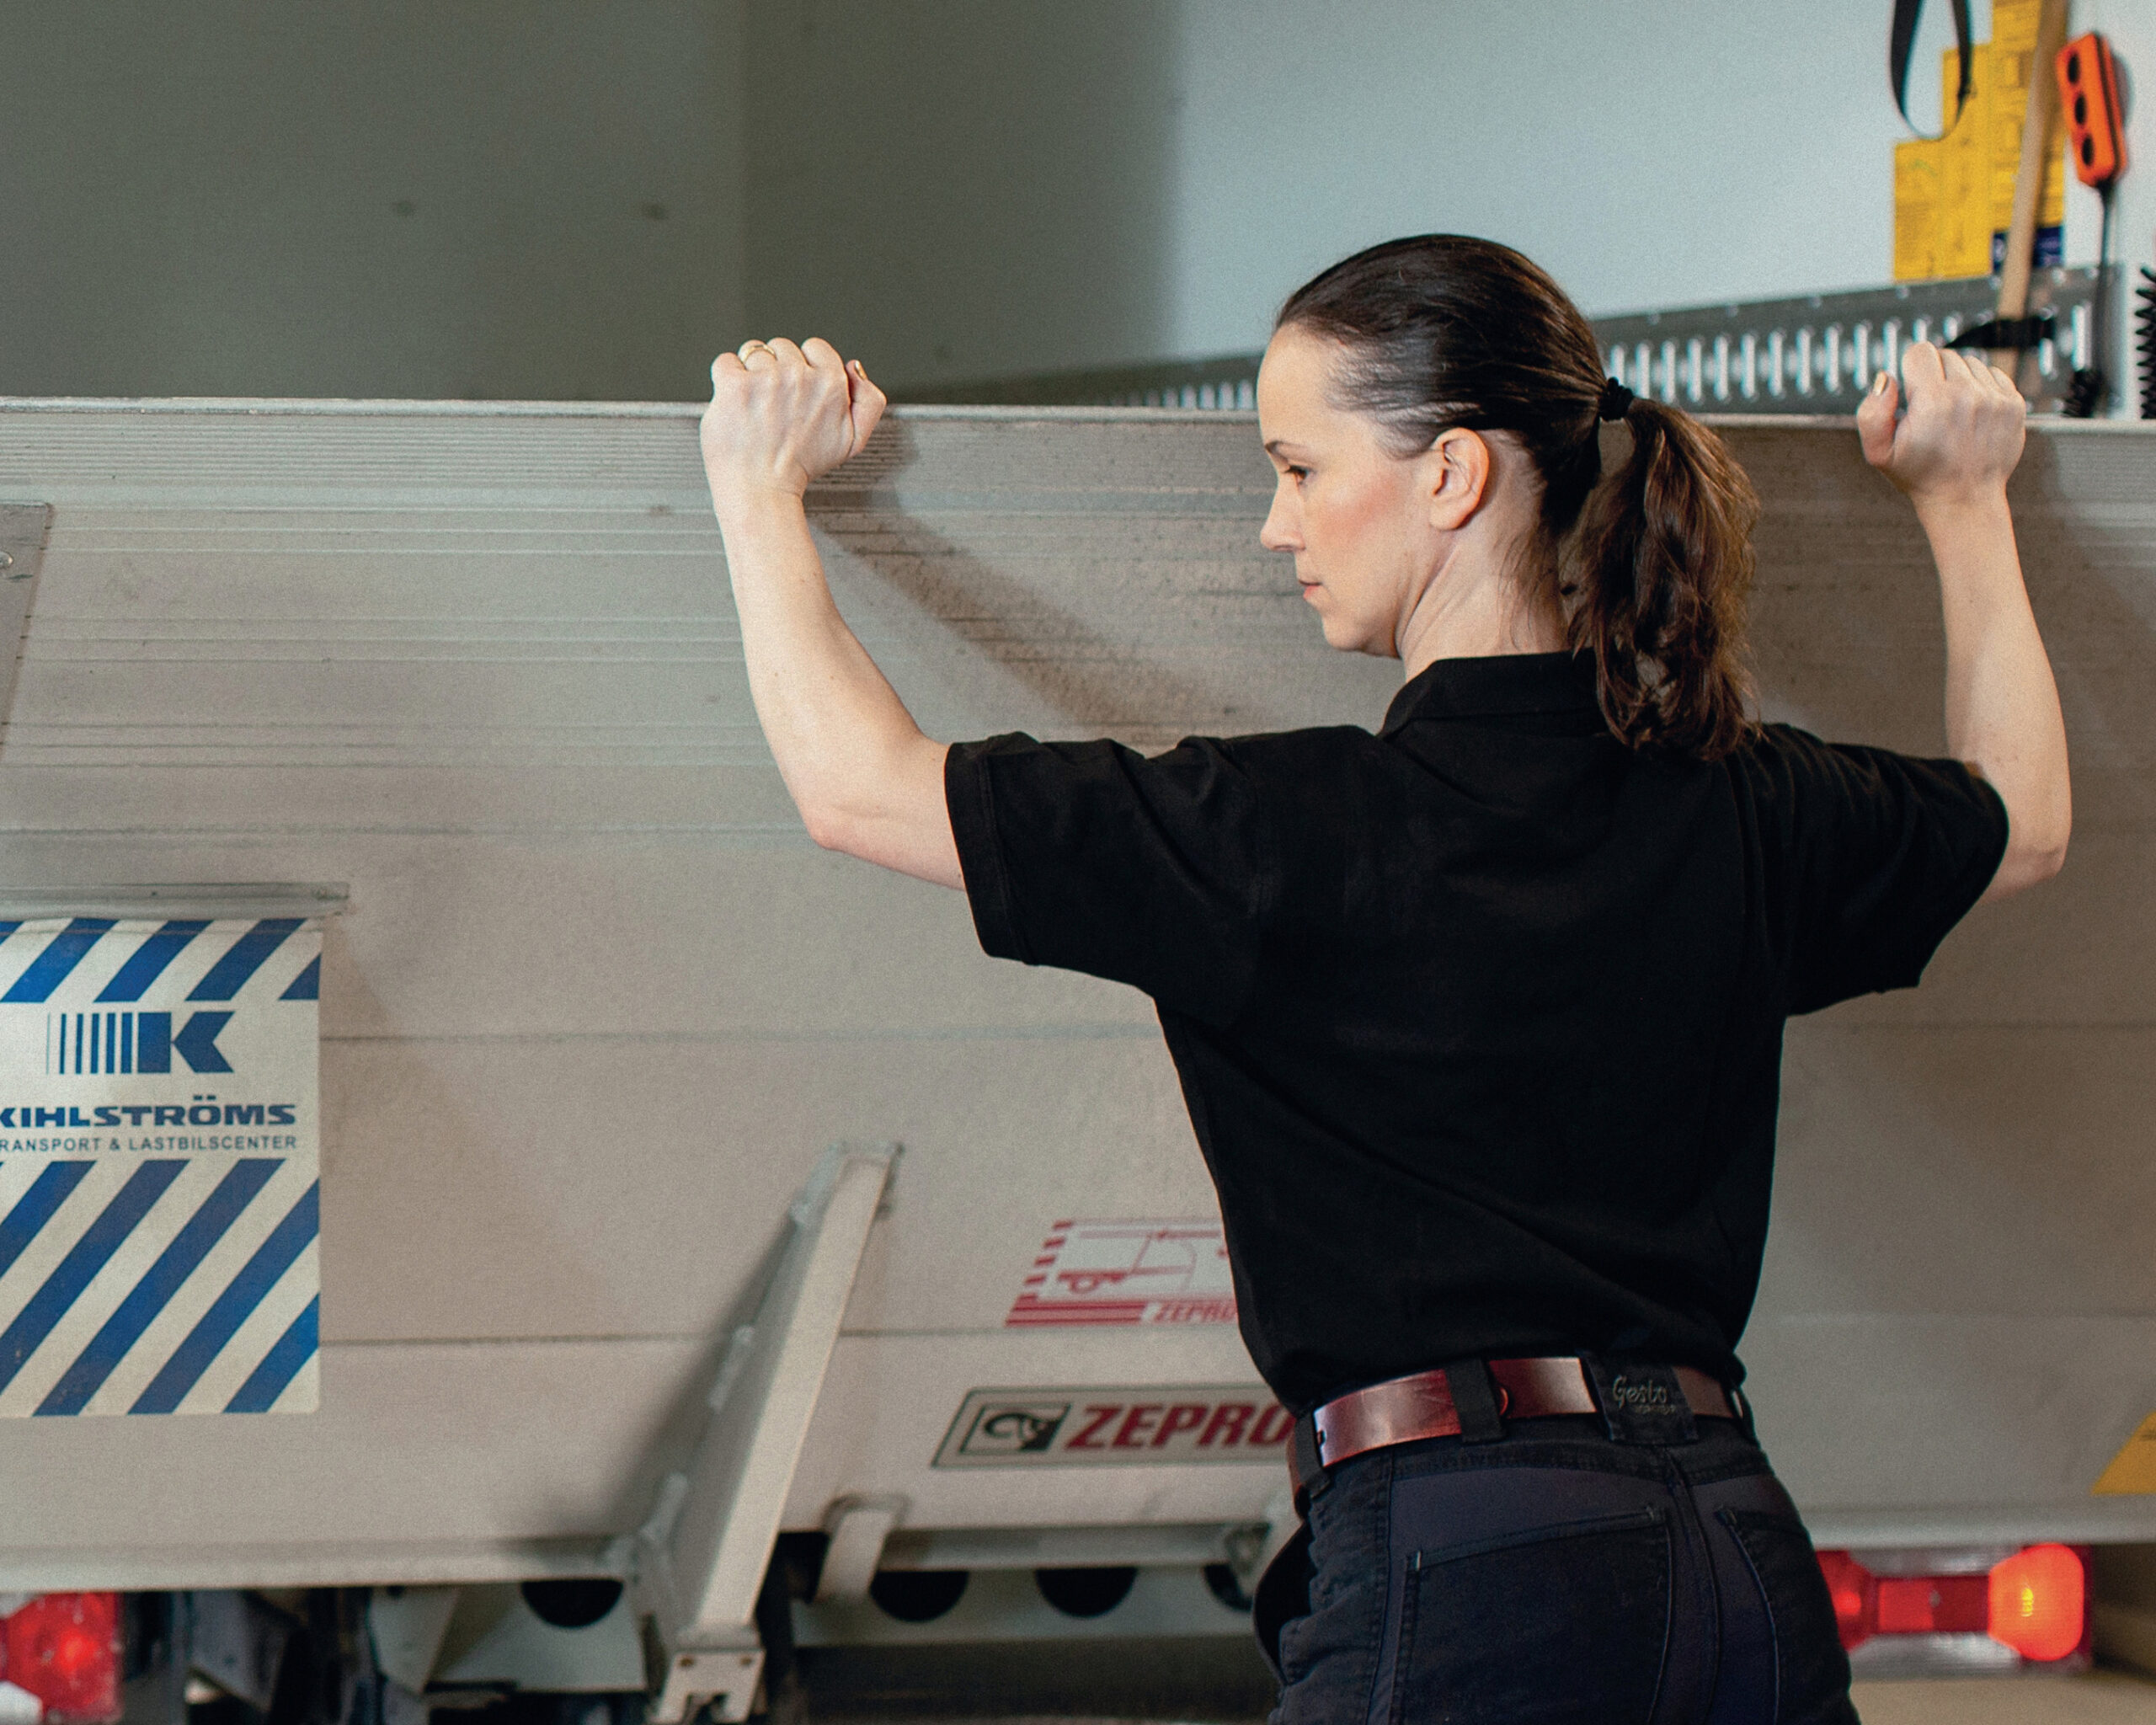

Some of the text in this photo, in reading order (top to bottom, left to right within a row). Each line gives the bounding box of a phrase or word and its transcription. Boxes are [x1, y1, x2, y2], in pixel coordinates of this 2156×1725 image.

[0, 1094, 296, 1128] KIHLSTRÖMS
[109, 1137, 120, 1151] &
[129, 1135, 297, 1151] LASTBILSCENTER
[1064, 1402, 1297, 1450] ZEPRO
